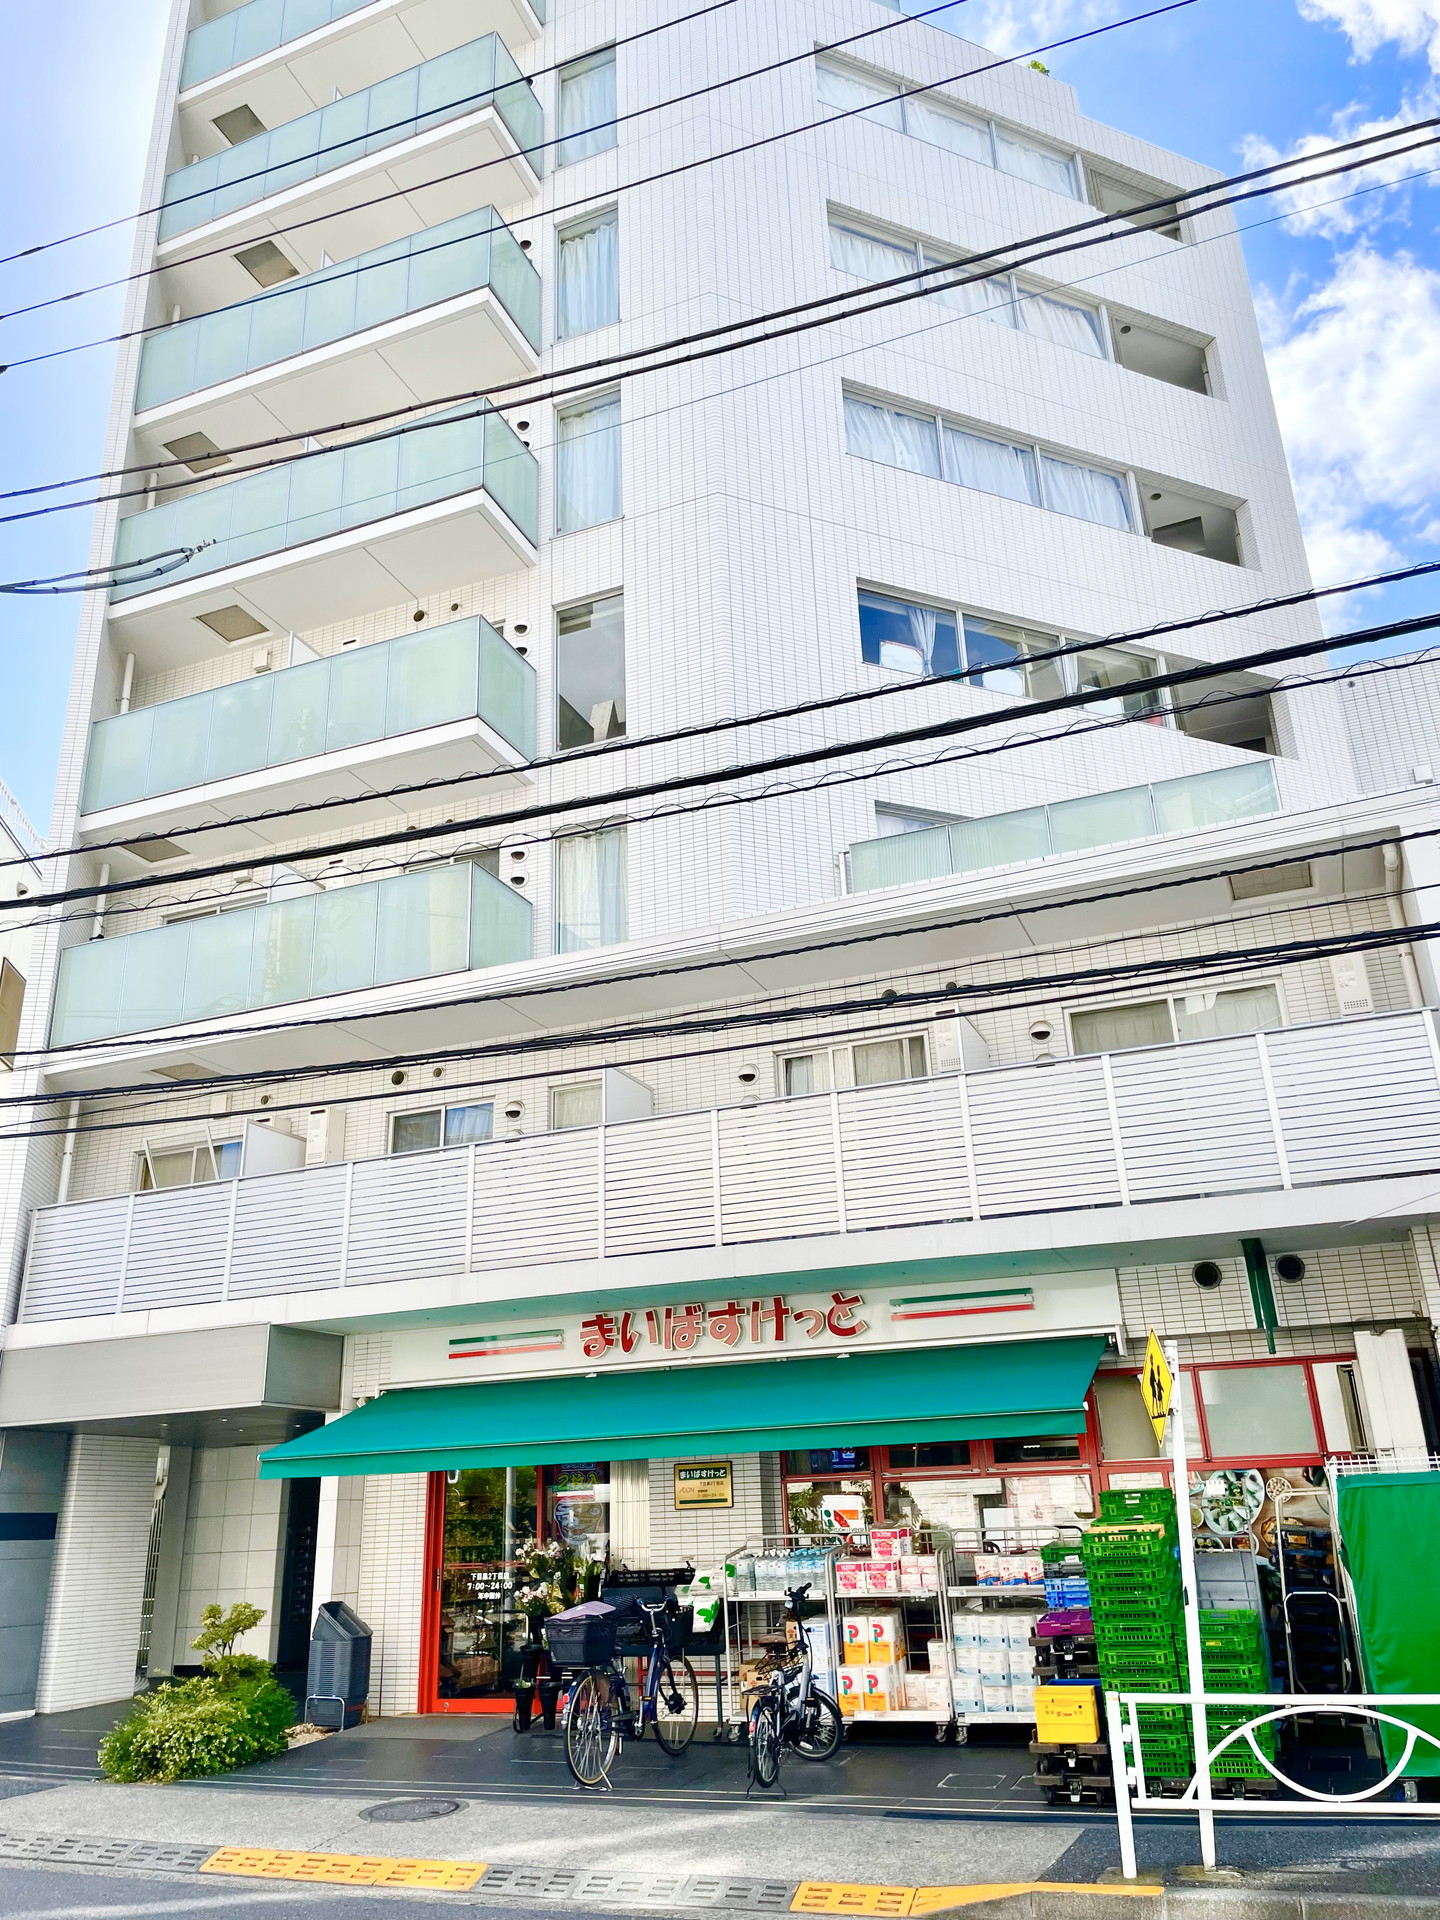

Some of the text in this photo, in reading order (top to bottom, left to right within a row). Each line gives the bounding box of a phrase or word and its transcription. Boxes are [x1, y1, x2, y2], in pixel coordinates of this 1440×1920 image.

[579, 1291, 869, 1358] まいばすけっと
